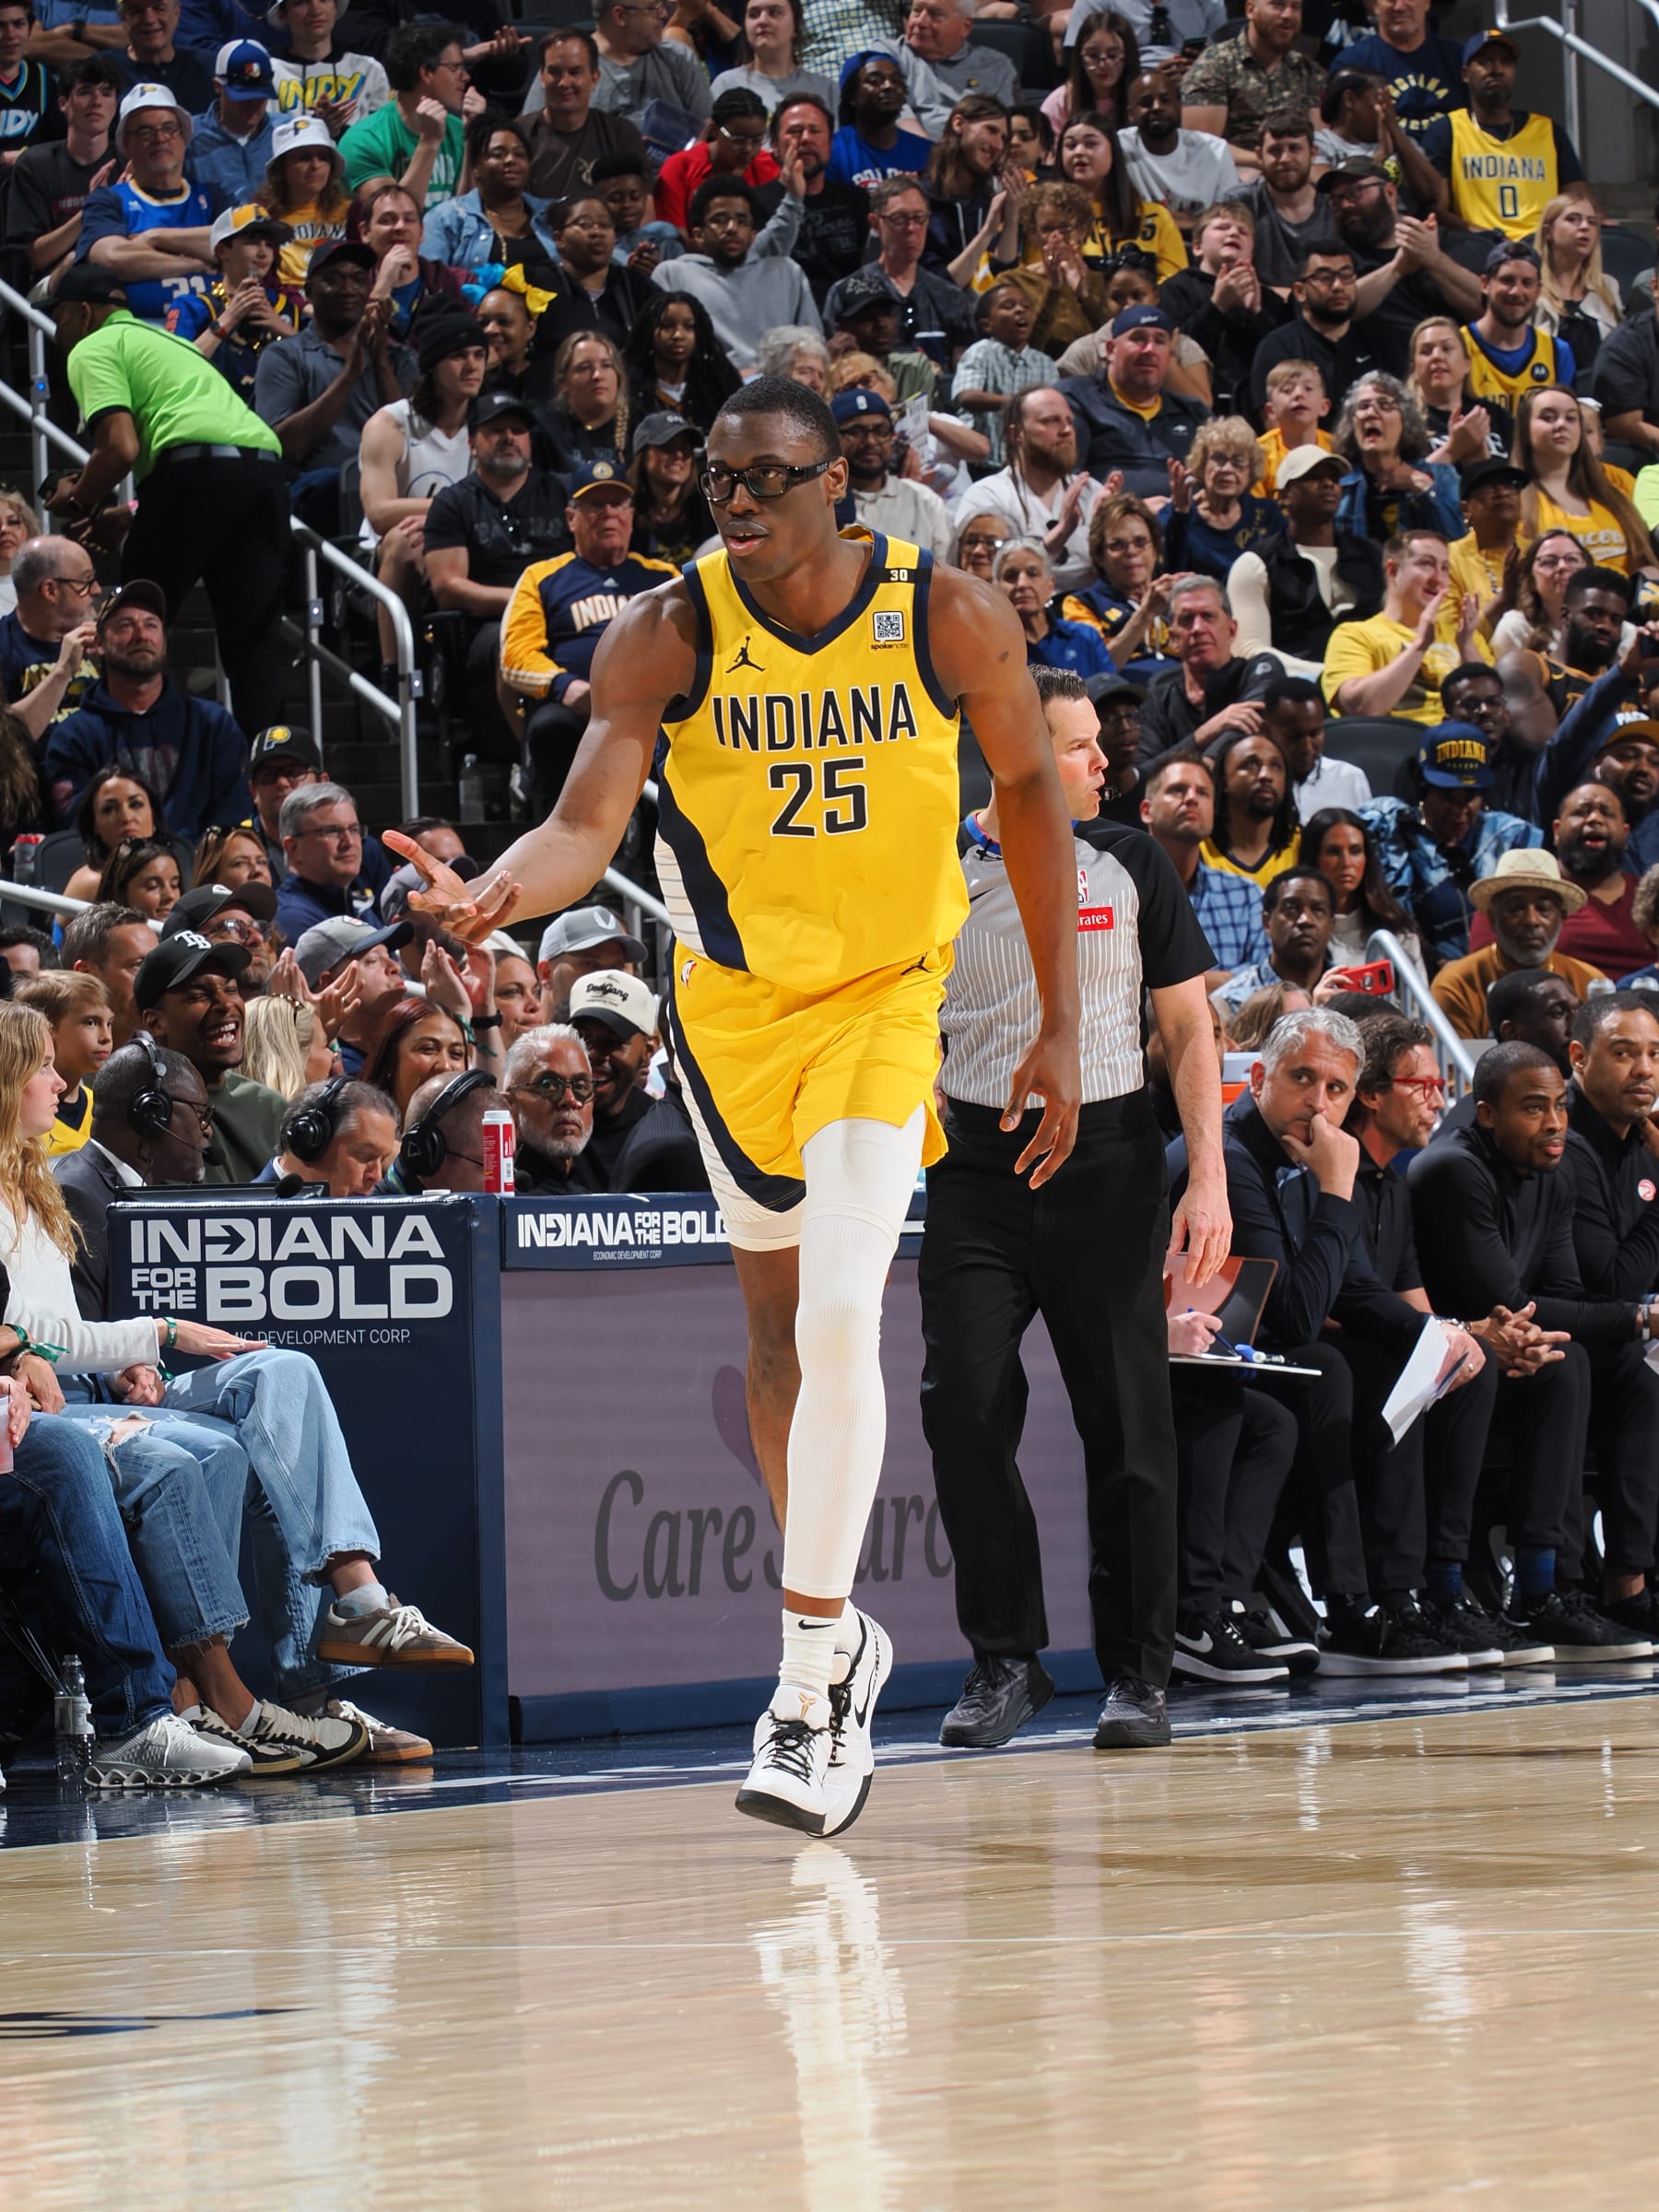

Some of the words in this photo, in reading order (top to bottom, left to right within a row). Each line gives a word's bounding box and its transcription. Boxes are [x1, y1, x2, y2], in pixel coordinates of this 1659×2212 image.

[0, 109, 40, 139] DY
[1463, 154, 1547, 183] INDIANA
[1500, 183, 1520, 219] 0
[889, 569, 909, 582] 30
[870, 642, 910, 651] spokenote
[712, 681, 919, 753] INDIANA
[1436, 739, 1487, 764] INDIANA
[769, 755, 869, 839] 25
[1078, 913, 1109, 927] rates
[174, 929, 212, 951] TB
[586, 982, 629, 1002] DadGang
[517, 1211, 635, 1248] INDIANA
[634, 1210, 661, 1228] FOR
[130, 1215, 445, 1264] INDIANA
[635, 1229, 662, 1245] THE
[593, 1250, 617, 1260] ECONOMIC
[618, 1250, 649, 1260] DEVELOPMENT
[131, 1267, 196, 1288] FOR
[132, 1289, 196, 1311] THE
[206, 1264, 453, 1322] BOLD
[258, 1329, 366, 1346] DEVELOPMENT
[370, 1328, 410, 1346] CORP.
